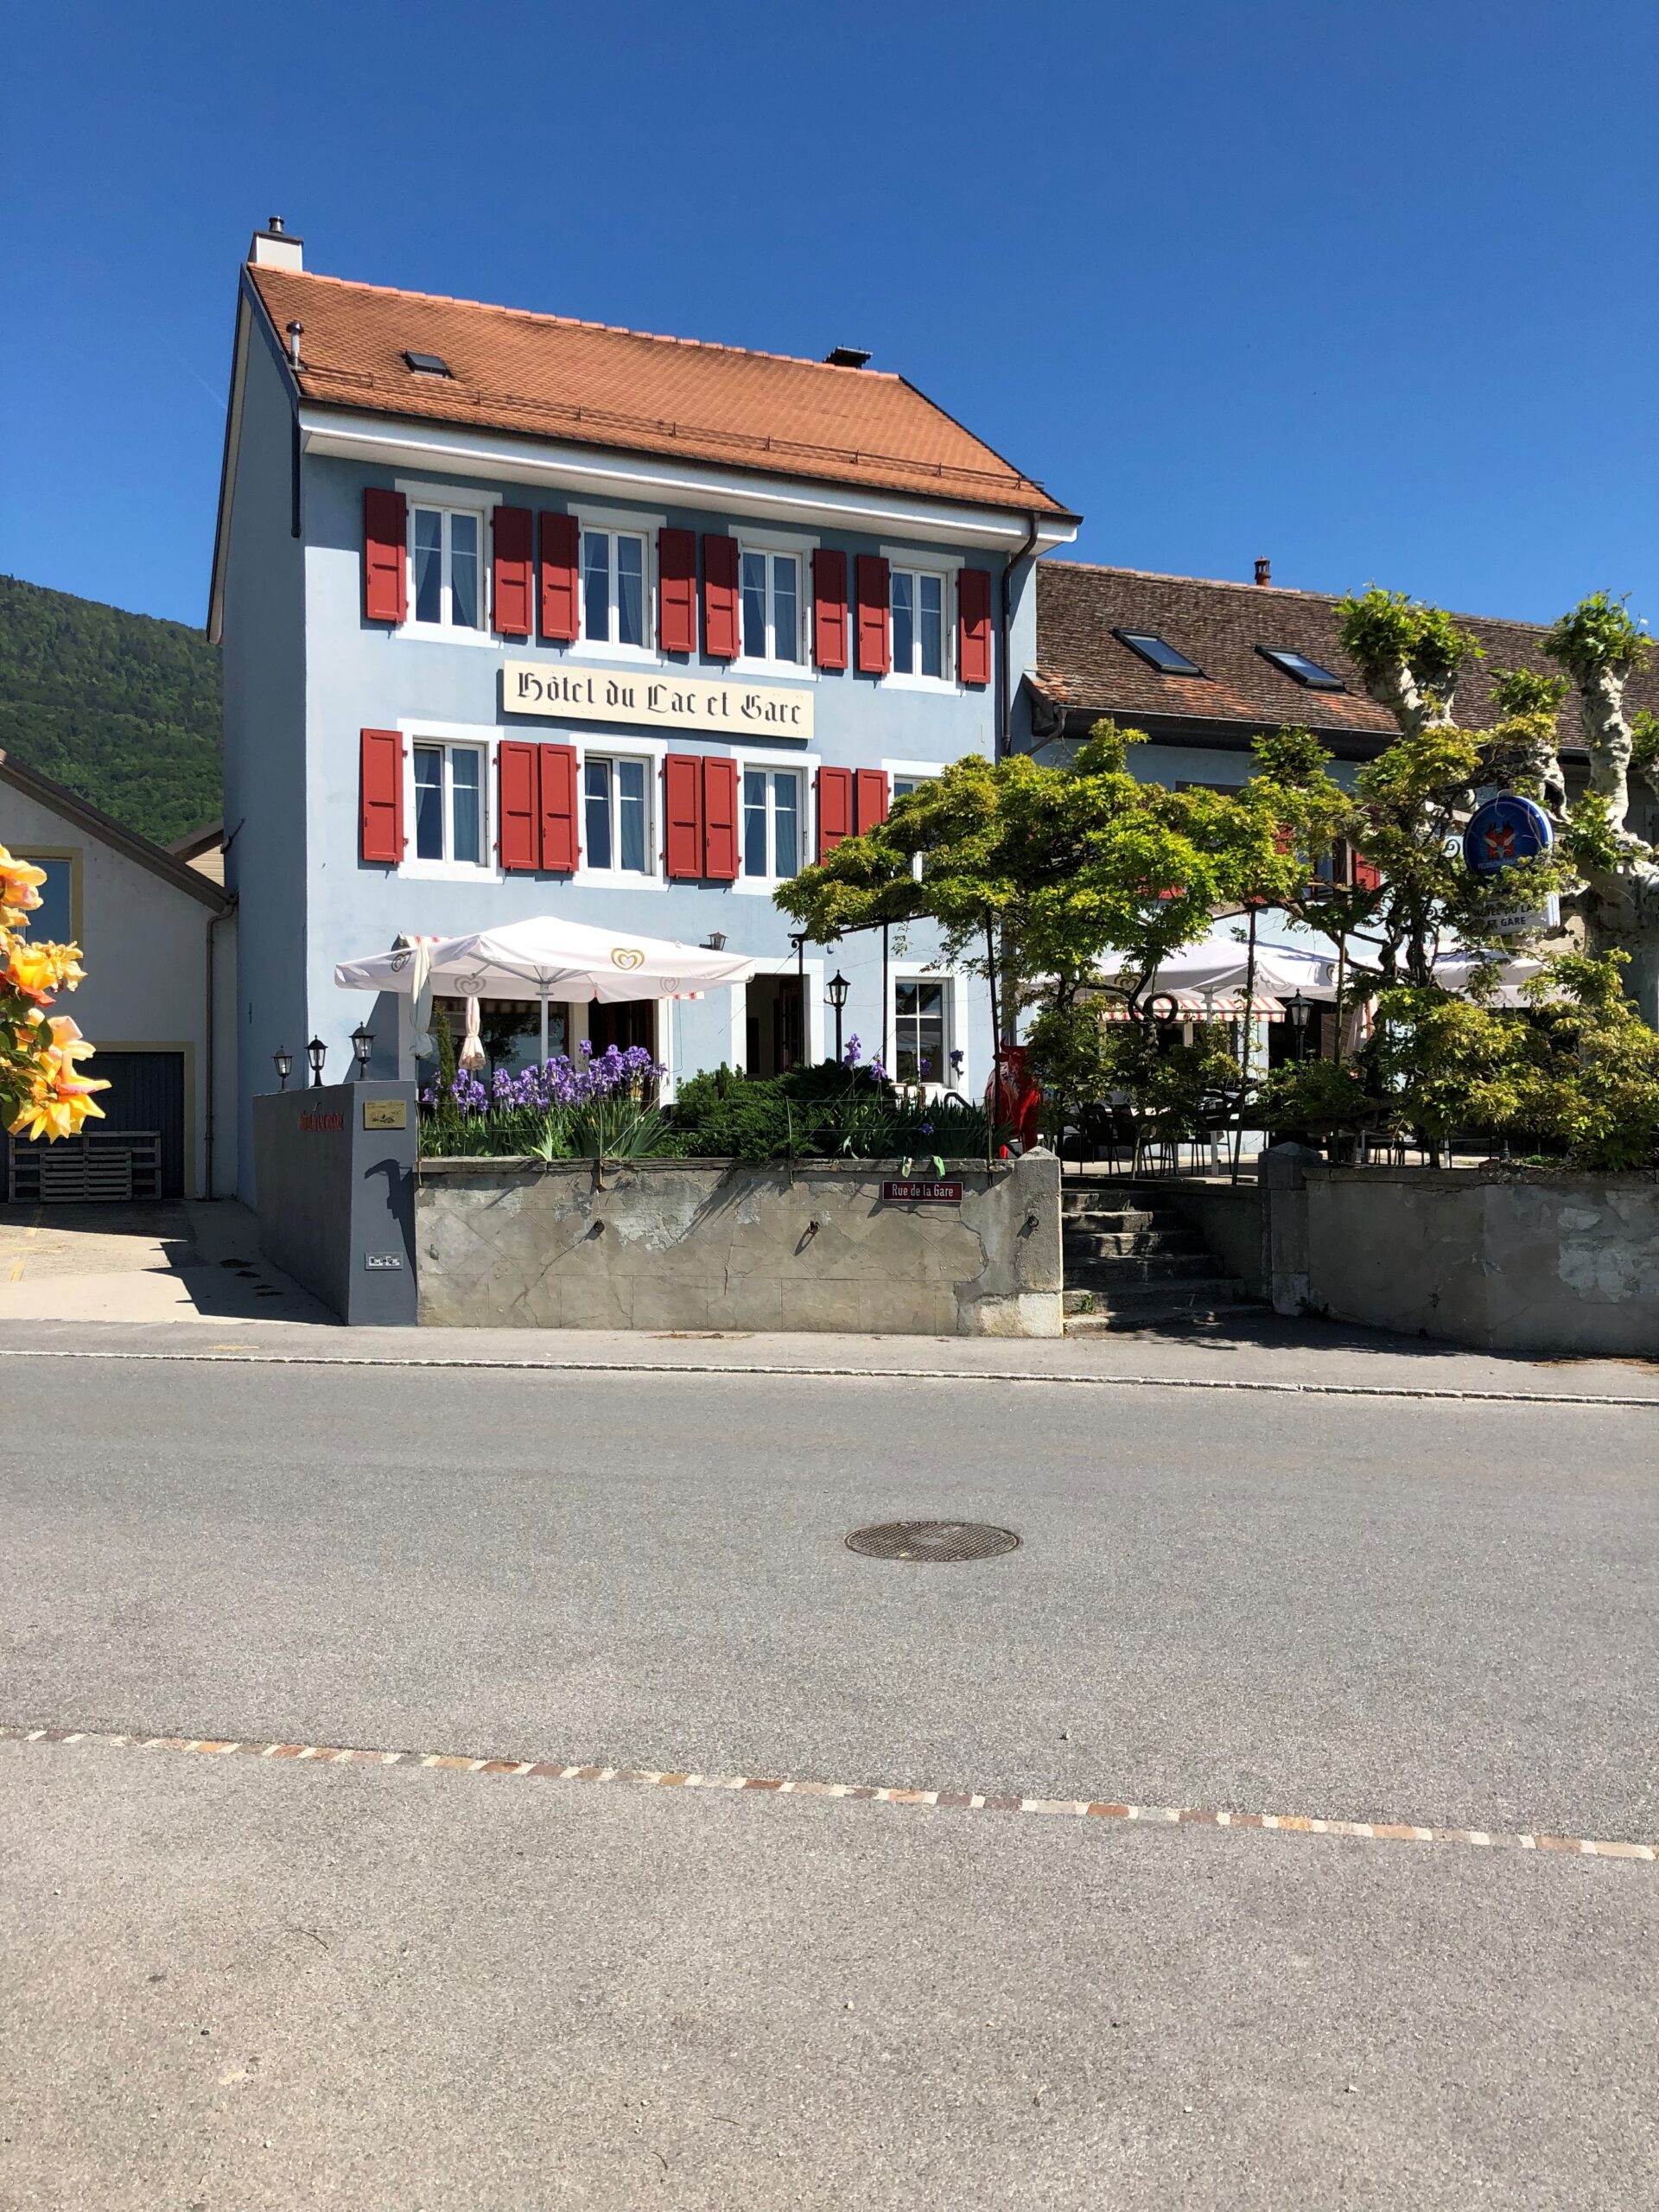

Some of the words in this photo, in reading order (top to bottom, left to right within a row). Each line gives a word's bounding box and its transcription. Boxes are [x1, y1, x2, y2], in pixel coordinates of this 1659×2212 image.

[517, 672, 595, 704] Hôtel
[606, 680, 636, 708] du
[647, 683, 698, 714] Lac
[707, 691, 730, 716] et
[741, 694, 802, 725] Gare
[1522, 904, 1534, 912] LA
[1501, 917, 1526, 926] GARE
[892, 1183, 908, 1197] Rue
[910, 1184, 921, 1197] de
[923, 1184, 931, 1197] la
[934, 1184, 954, 1197] Gare
